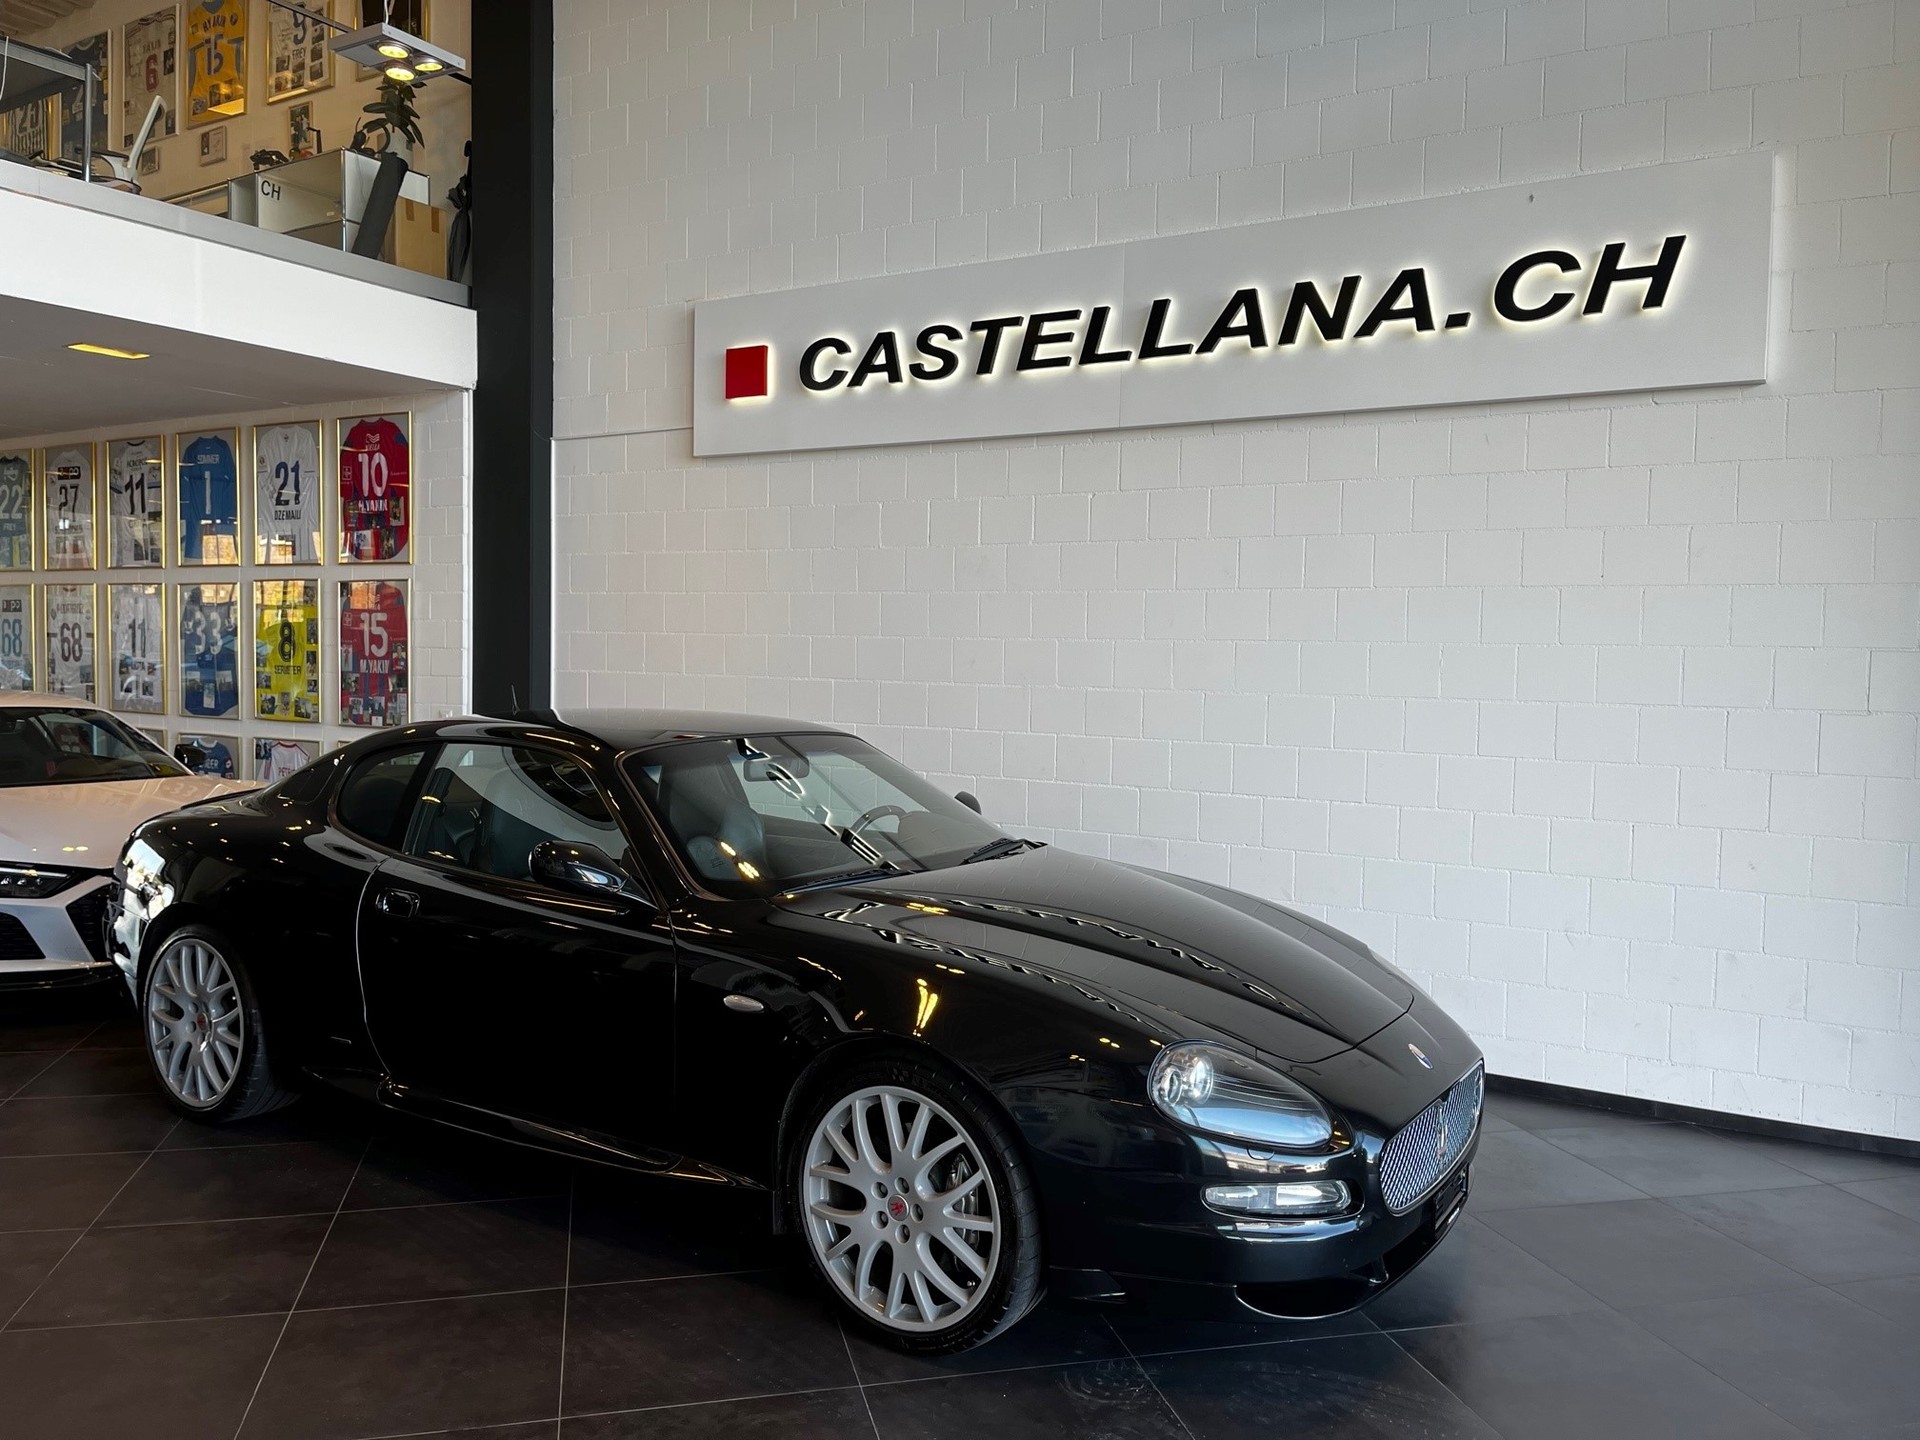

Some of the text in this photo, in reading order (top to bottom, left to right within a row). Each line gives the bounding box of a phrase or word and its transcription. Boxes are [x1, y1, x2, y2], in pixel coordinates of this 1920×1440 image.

[145, 53, 159, 93] 6
[204, 33, 224, 76] 15
[292, 47, 306, 60] FREY
[261, 180, 281, 201] CH
[798, 234, 1686, 392] CASTELLANA.CH
[197, 454, 220, 465] SOMMER
[358, 452, 388, 497] 10
[0, 484, 23, 520] 22
[124, 473, 146, 515] 11
[204, 471, 212, 515] 1
[275, 460, 301, 506] 21
[59, 484, 80, 523] 27
[274, 510, 302, 521] DZEMAILI
[1, 618, 22, 657] 68
[60, 622, 83, 662] 68
[128, 618, 146, 658] 11
[194, 611, 222, 655] 33
[278, 619, 296, 663] 8
[360, 612, 389, 658] 15
